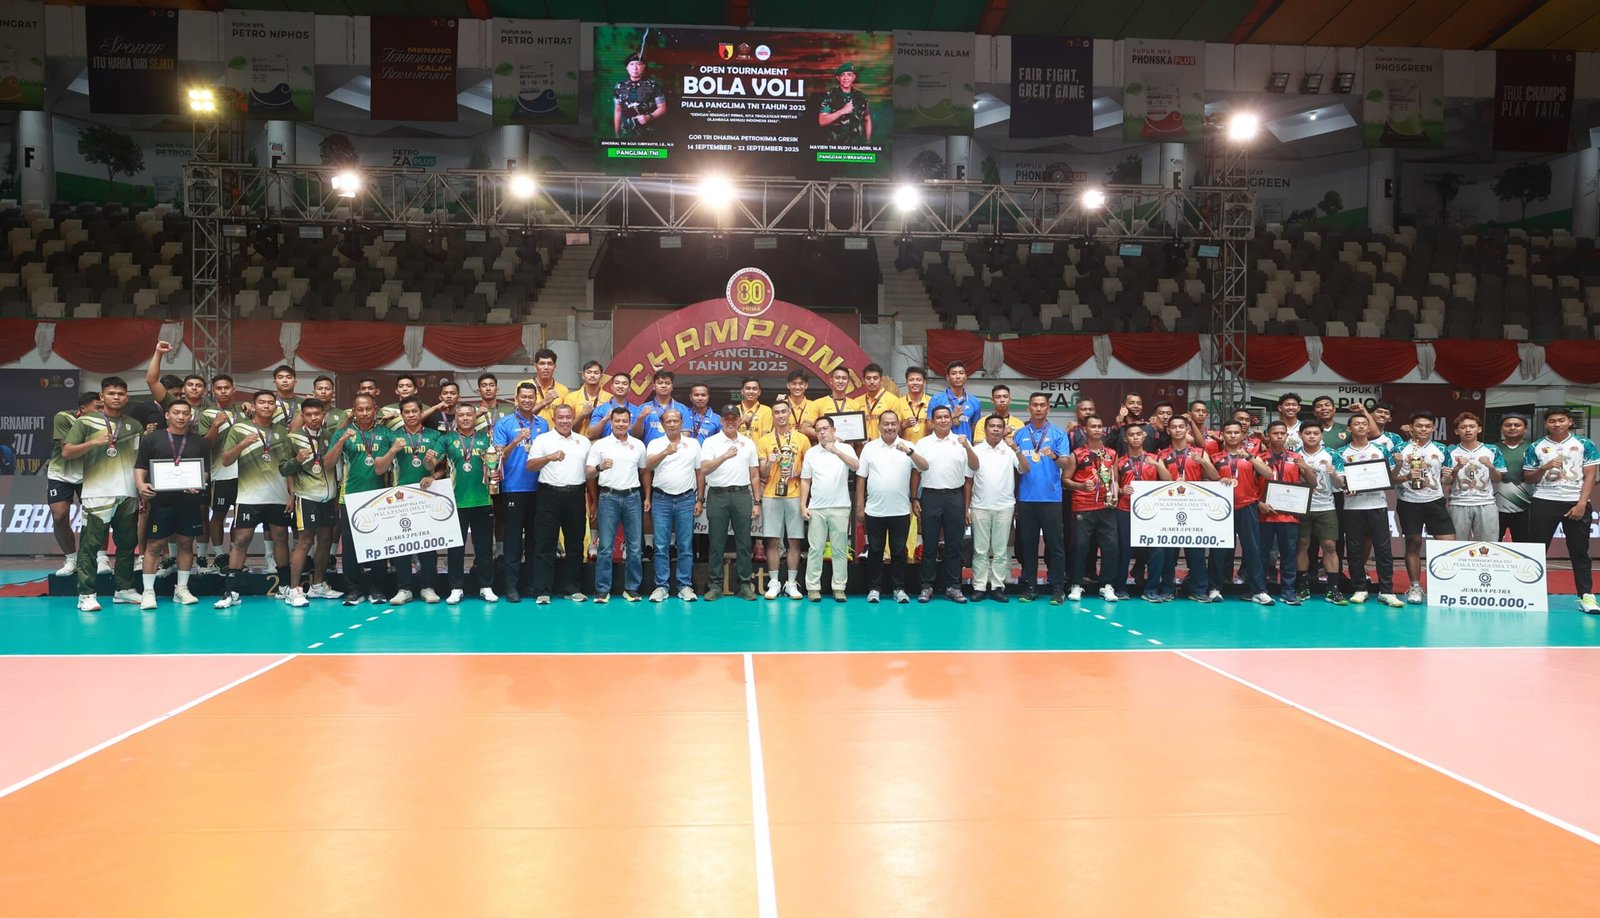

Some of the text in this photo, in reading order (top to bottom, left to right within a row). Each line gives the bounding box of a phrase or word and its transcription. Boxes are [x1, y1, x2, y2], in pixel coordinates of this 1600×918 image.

[232, 29, 309, 39] PETRO NIPHOS
[898, 48, 941, 56] PHONSKA
[93, 56, 106, 68] ITU
[150, 57, 174, 70] SEJATI
[1132, 55, 1195, 65] PHONSKA PLUS
[727, 66, 788, 75] TOURNAMENT
[1376, 64, 1432, 72] PHOSGREEN
[1019, 68, 1079, 84] FAIR FIGHT,
[684, 76, 804, 97] BOLA VOLI
[1019, 84, 1085, 98] GREAT GAME
[1504, 86, 1566, 102] TRUE CHAMPS
[1502, 102, 1564, 118] PLAY FAIR.
[24, 148, 34, 168] F
[392, 156, 411, 166] ZA
[957, 165, 965, 179] E
[1173, 172, 1181, 190] E
[737, 280, 765, 304] 80
[704, 348, 783, 358] ANGLIM
[688, 361, 788, 371] TAHUN 2025
[1040, 382, 1080, 390] PETRO
[1469, 471, 1474, 480] 9
[694, 522, 707, 532] Rp
[1139, 535, 1225, 546] Rp 10.000.000,-
[366, 536, 454, 559] Rp 15.000.000,-
[1440, 595, 1534, 609] Rp 5.000.000,-
